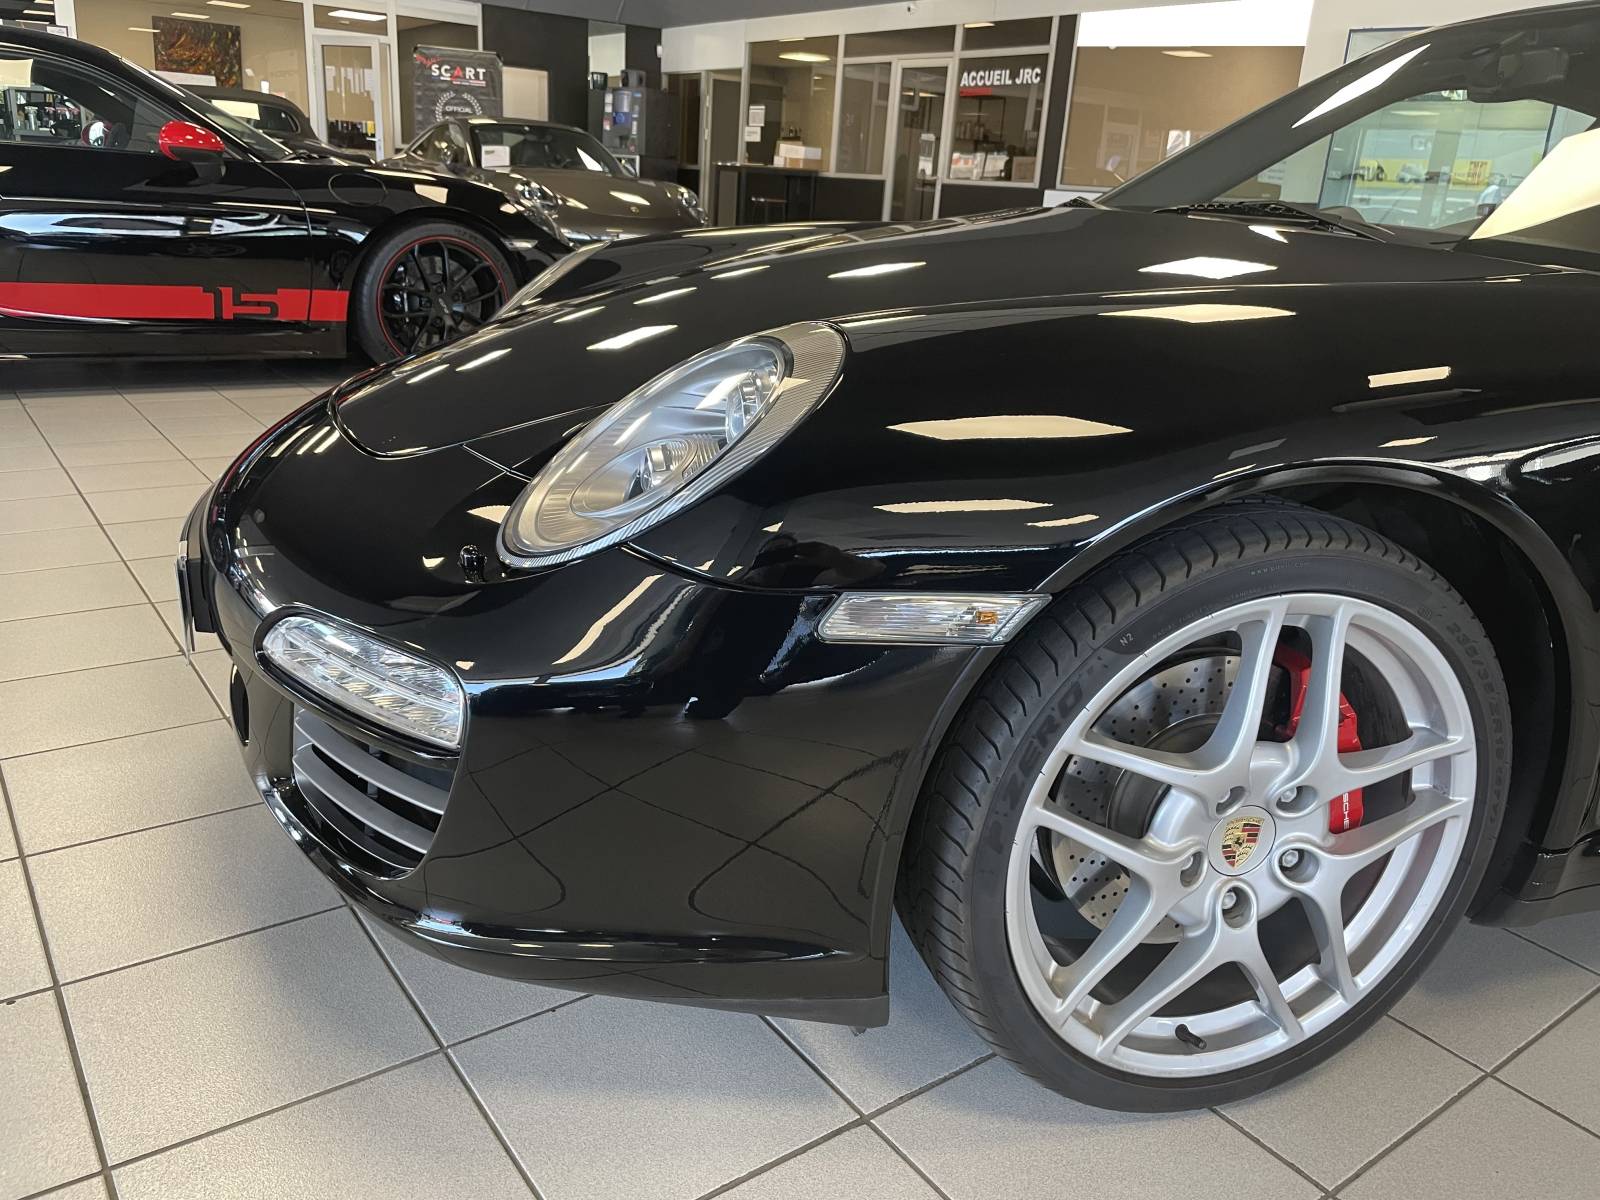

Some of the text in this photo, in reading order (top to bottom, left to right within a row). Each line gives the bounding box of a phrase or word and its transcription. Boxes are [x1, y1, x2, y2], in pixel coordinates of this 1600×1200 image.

[431, 64, 486, 80] SCART
[960, 66, 1041, 87] ACCUEIL JRC
[445, 105, 473, 114] OFFICIAL
[1119, 632, 1135, 648] N2
[1003, 680, 1083, 811] ZERO
[1342, 792, 1350, 830] SCHE
